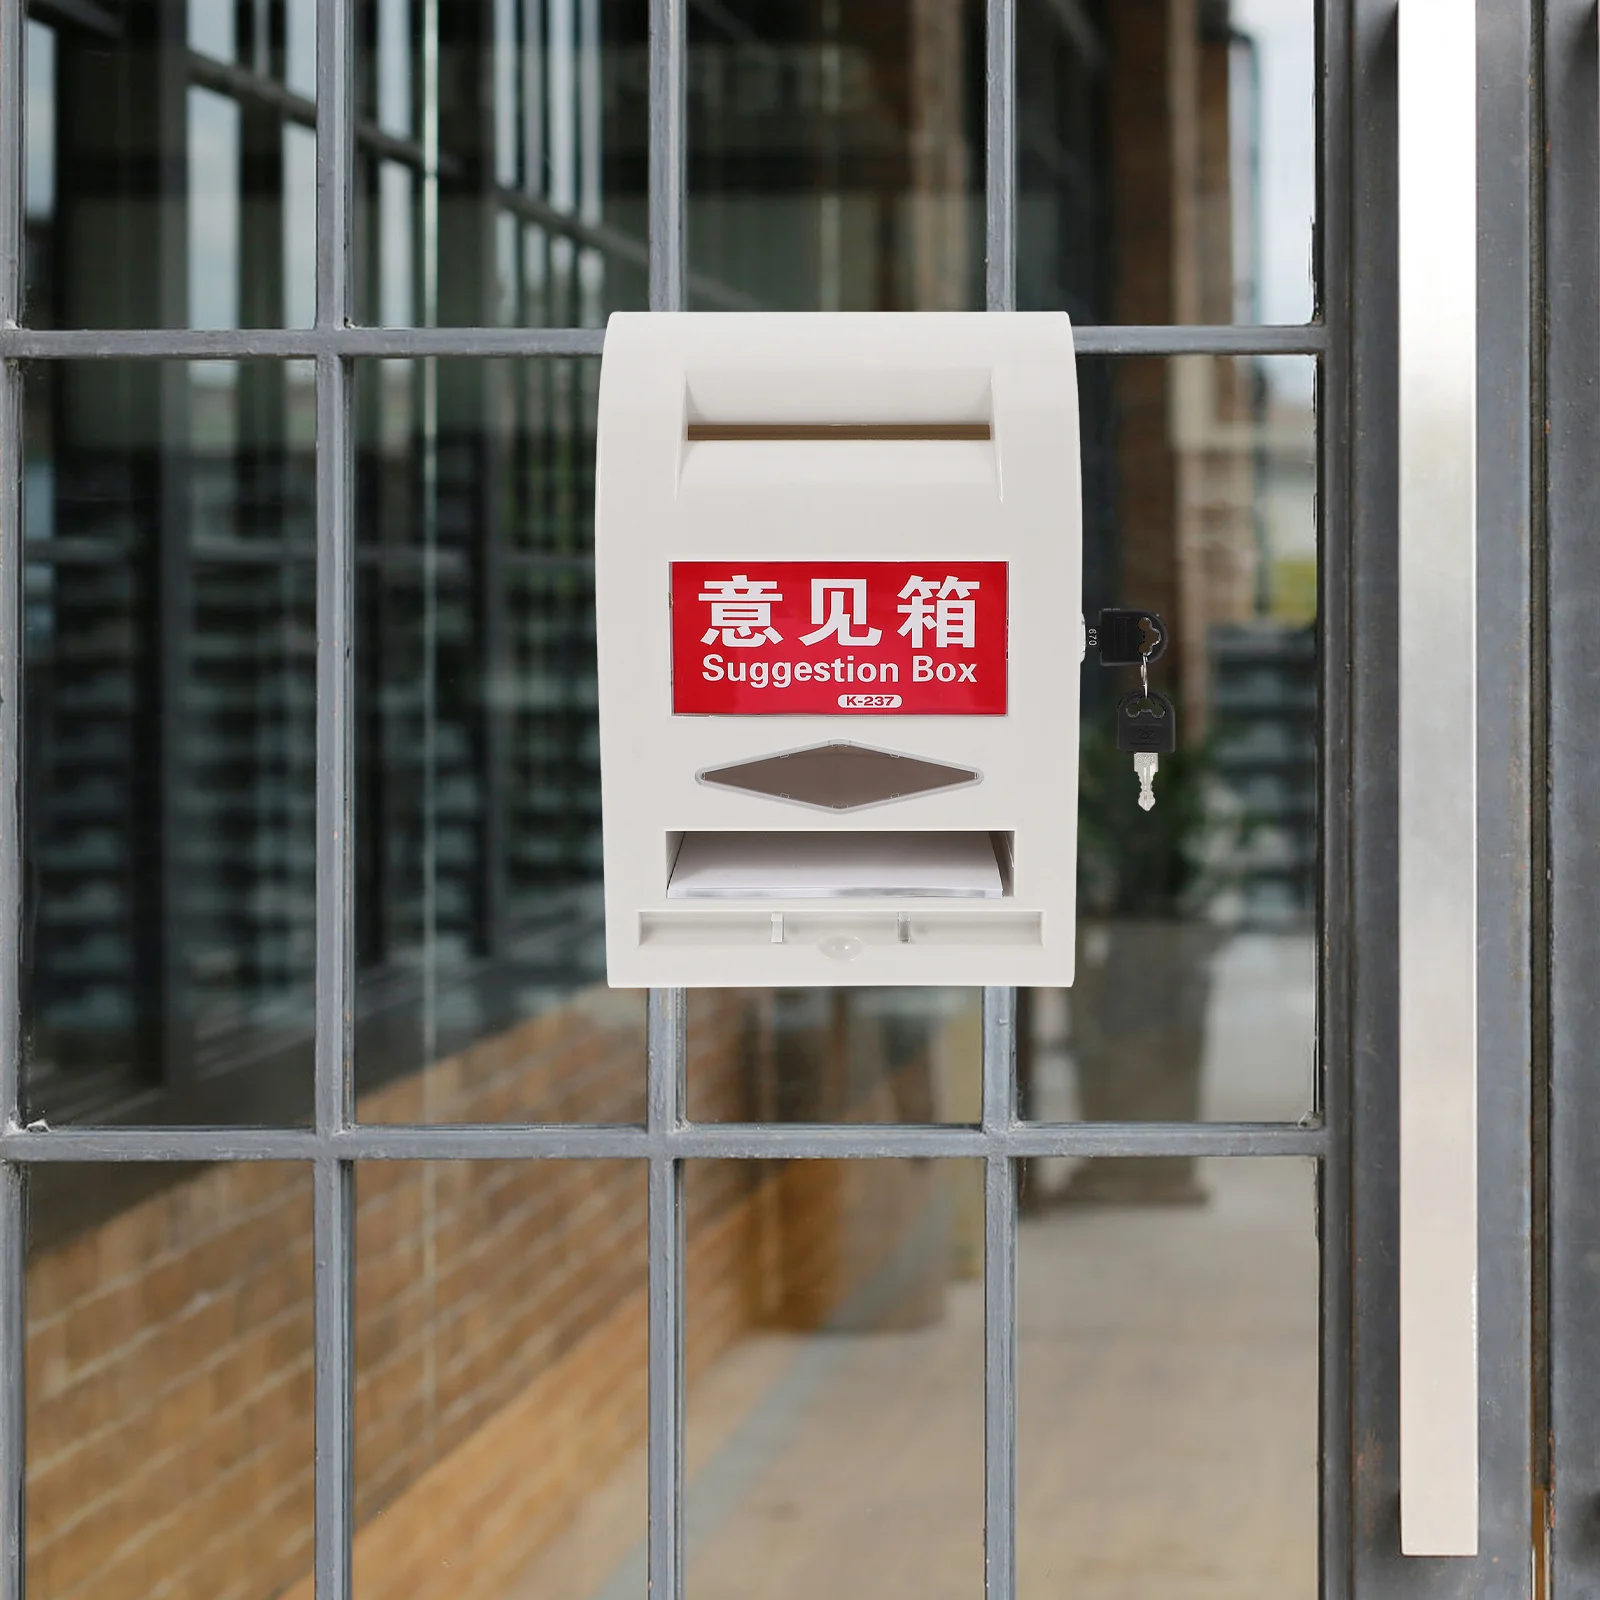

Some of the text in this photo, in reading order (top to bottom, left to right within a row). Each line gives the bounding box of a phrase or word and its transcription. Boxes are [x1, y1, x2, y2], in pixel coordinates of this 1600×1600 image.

[698, 575, 980, 648] 意见箱
[702, 654, 978, 688] Suggestion Box
[846, 696, 895, 706] K-237
